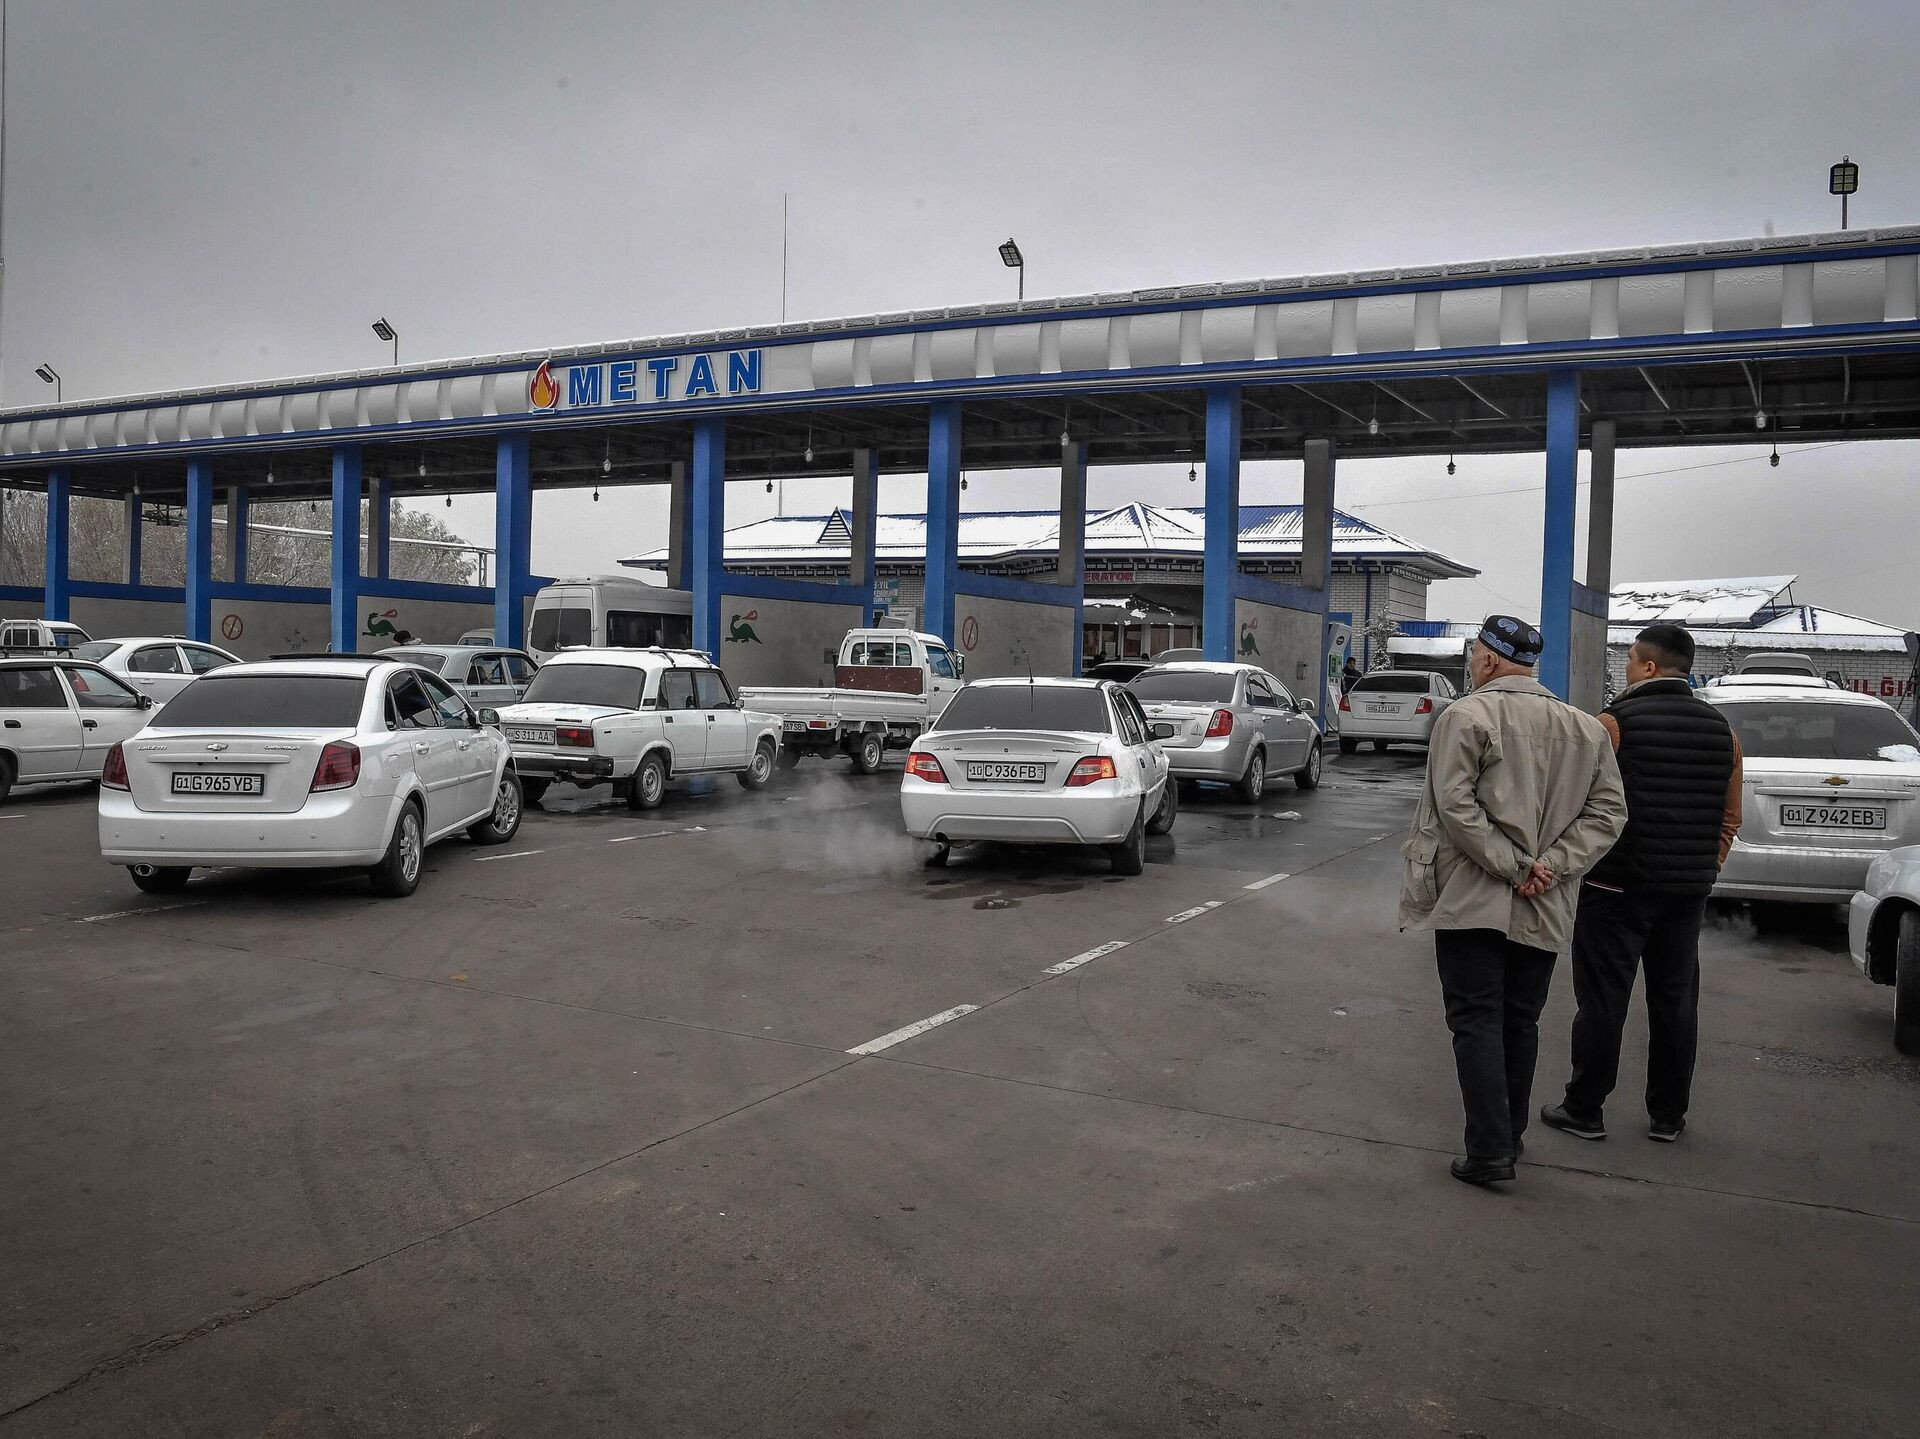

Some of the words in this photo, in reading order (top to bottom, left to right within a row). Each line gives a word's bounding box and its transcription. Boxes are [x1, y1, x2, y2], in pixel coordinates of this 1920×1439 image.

[567, 349, 762, 407] METAN
[514, 730, 520, 740] S
[521, 731, 535, 741] 311
[537, 731, 549, 741] AA
[971, 765, 982, 776] 10
[984, 765, 993, 777] C
[995, 766, 1017, 777] 936
[1019, 766, 1037, 778] FB
[176, 777, 189, 789] 01
[192, 776, 201, 790] G
[204, 776, 231, 791] 965
[233, 777, 253, 791] YB
[1786, 809, 1802, 821] 01
[1805, 808, 1816, 823] Z
[1819, 809, 1849, 825] 942
[1851, 809, 1874, 825] EB
